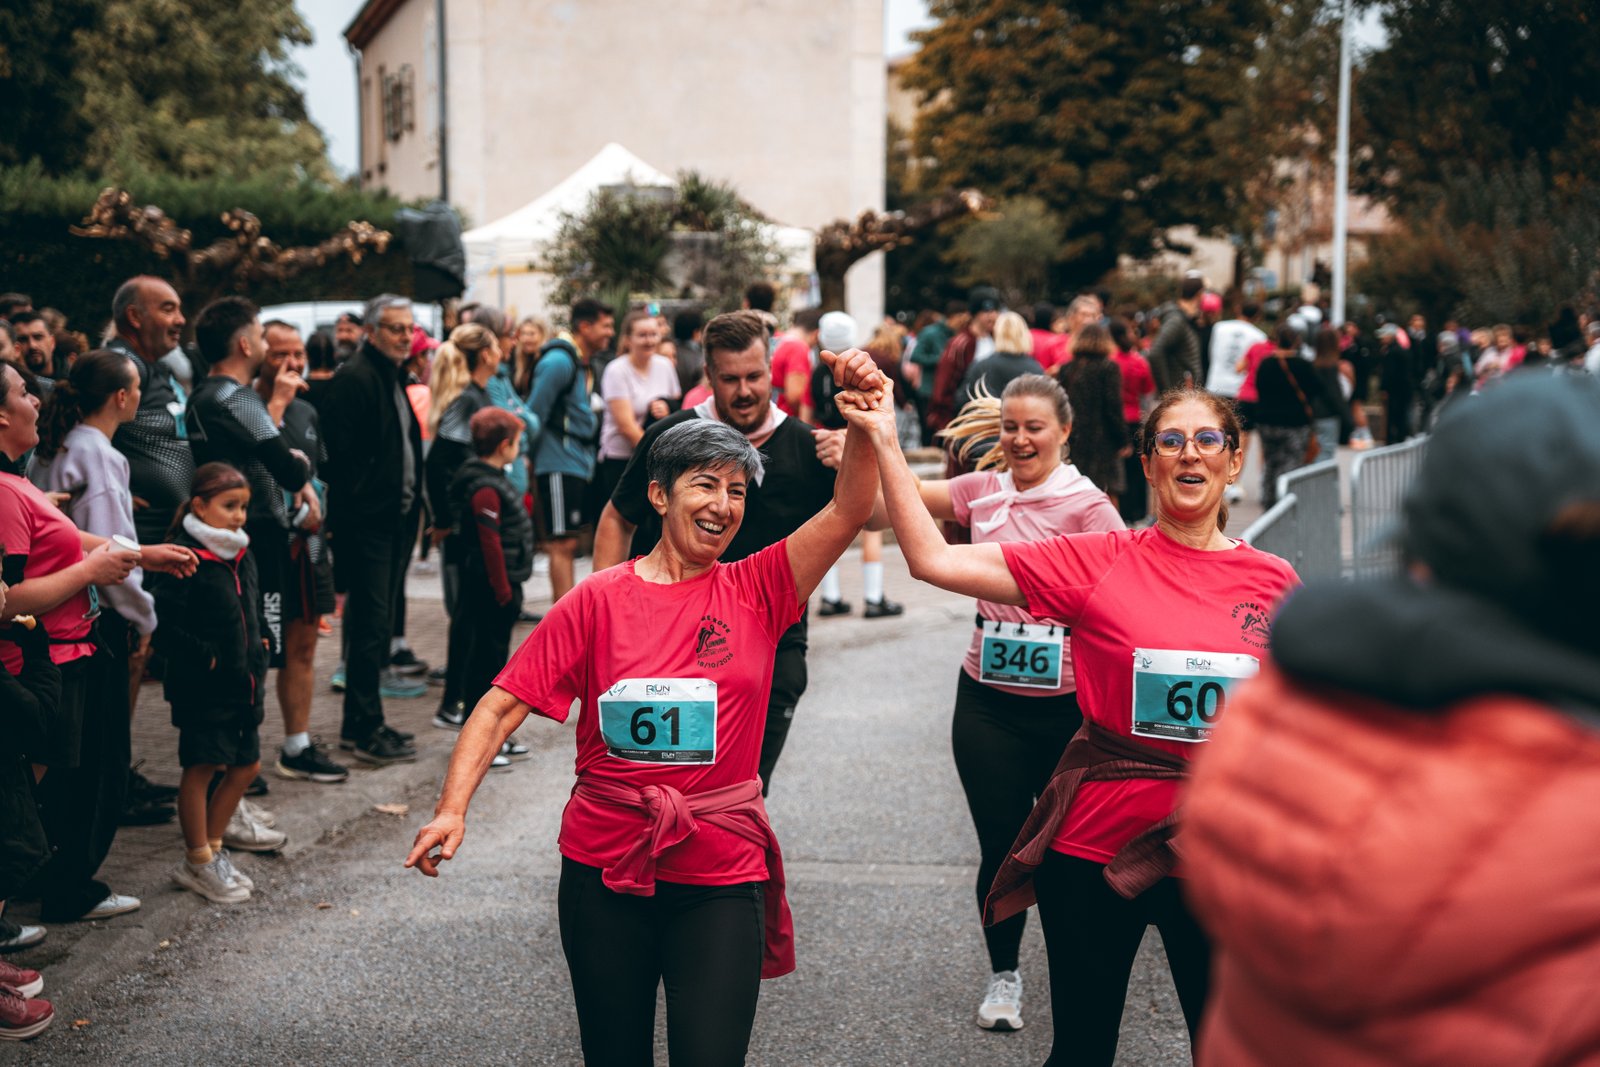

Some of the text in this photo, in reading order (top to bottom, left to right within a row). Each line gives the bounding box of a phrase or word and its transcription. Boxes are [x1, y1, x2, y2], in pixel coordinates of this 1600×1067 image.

[990, 642, 1050, 674] 346
[1186, 657, 1211, 666] RUN
[645, 684, 671, 692] RUN
[1166, 681, 1226, 723] 60
[630, 706, 680, 746] 61
